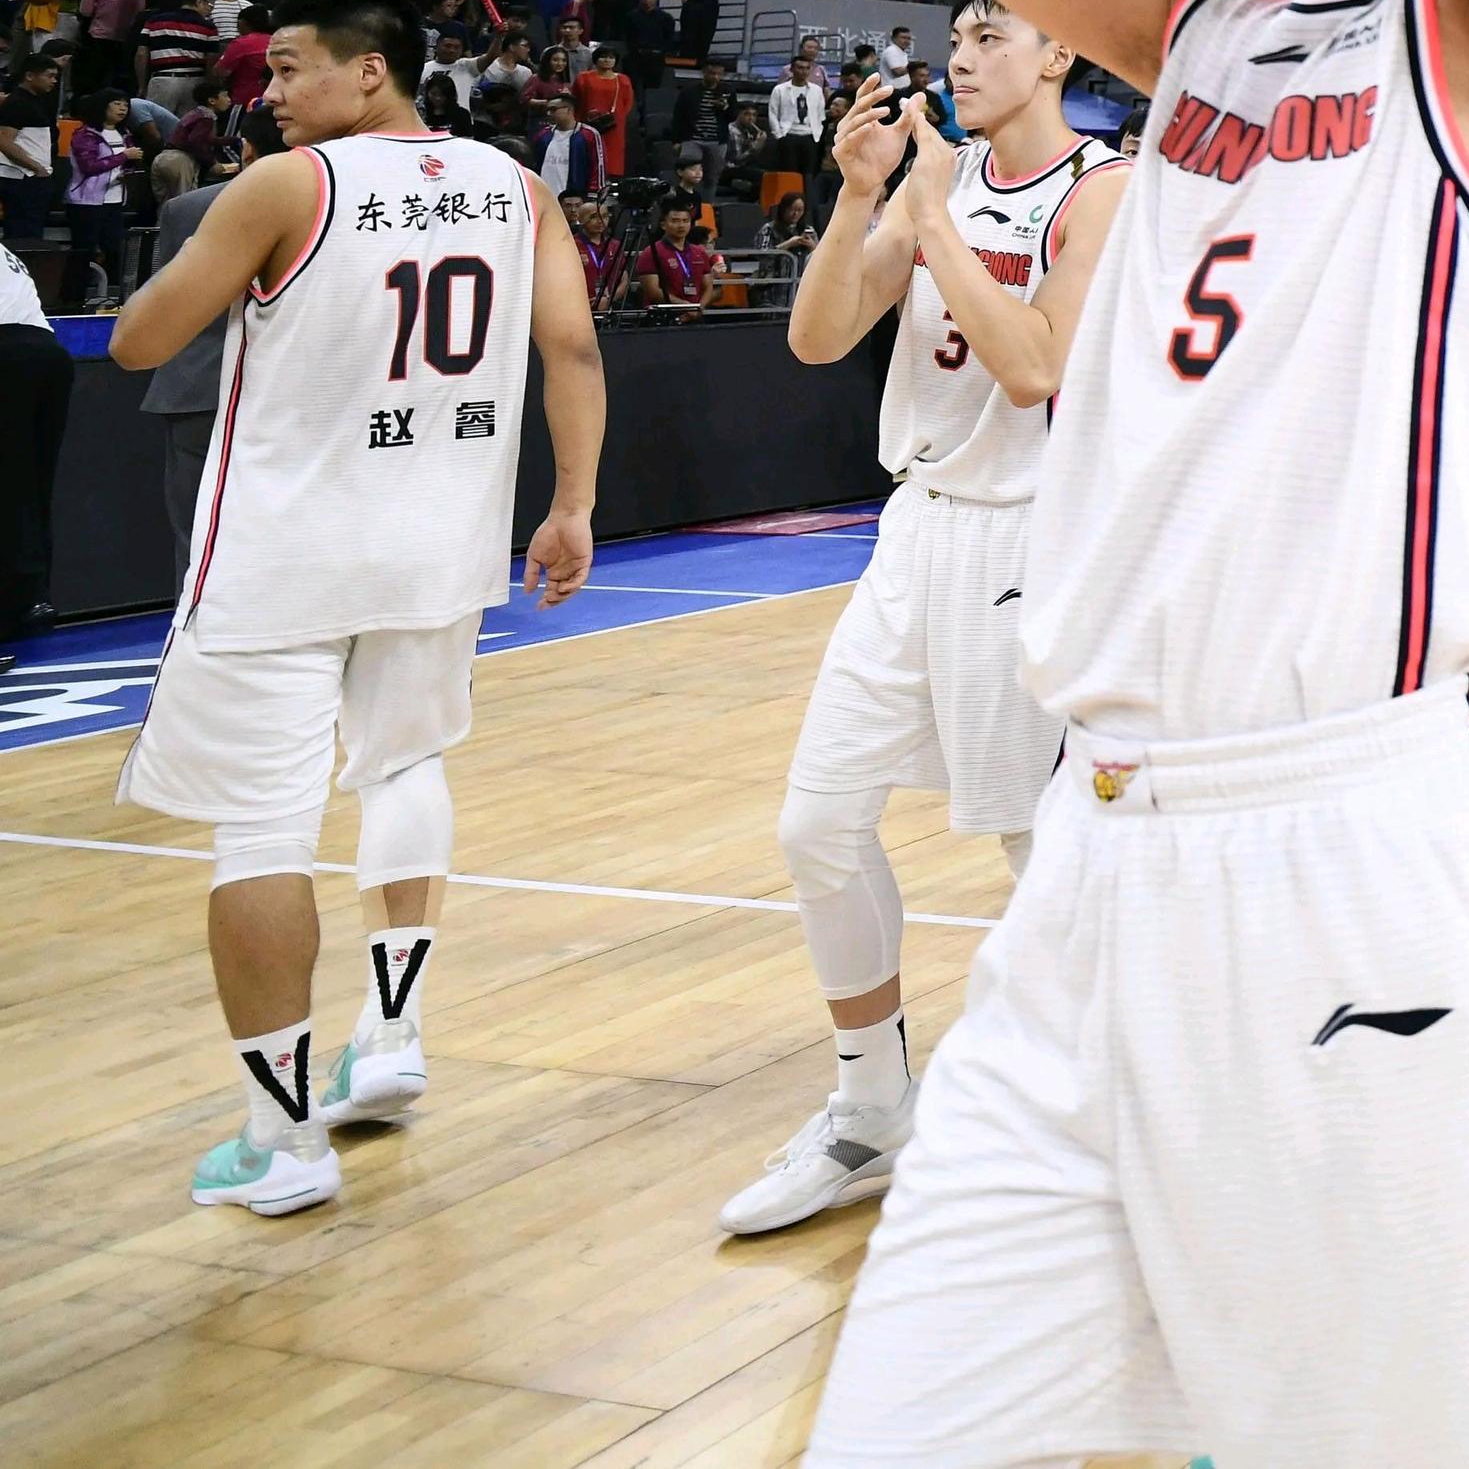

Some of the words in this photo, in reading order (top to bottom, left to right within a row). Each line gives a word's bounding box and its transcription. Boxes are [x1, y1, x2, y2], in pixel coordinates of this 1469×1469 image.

[356, 192, 513, 233] 东莞银行
[384, 255, 494, 383] 10
[1166, 232, 1257, 383] 5
